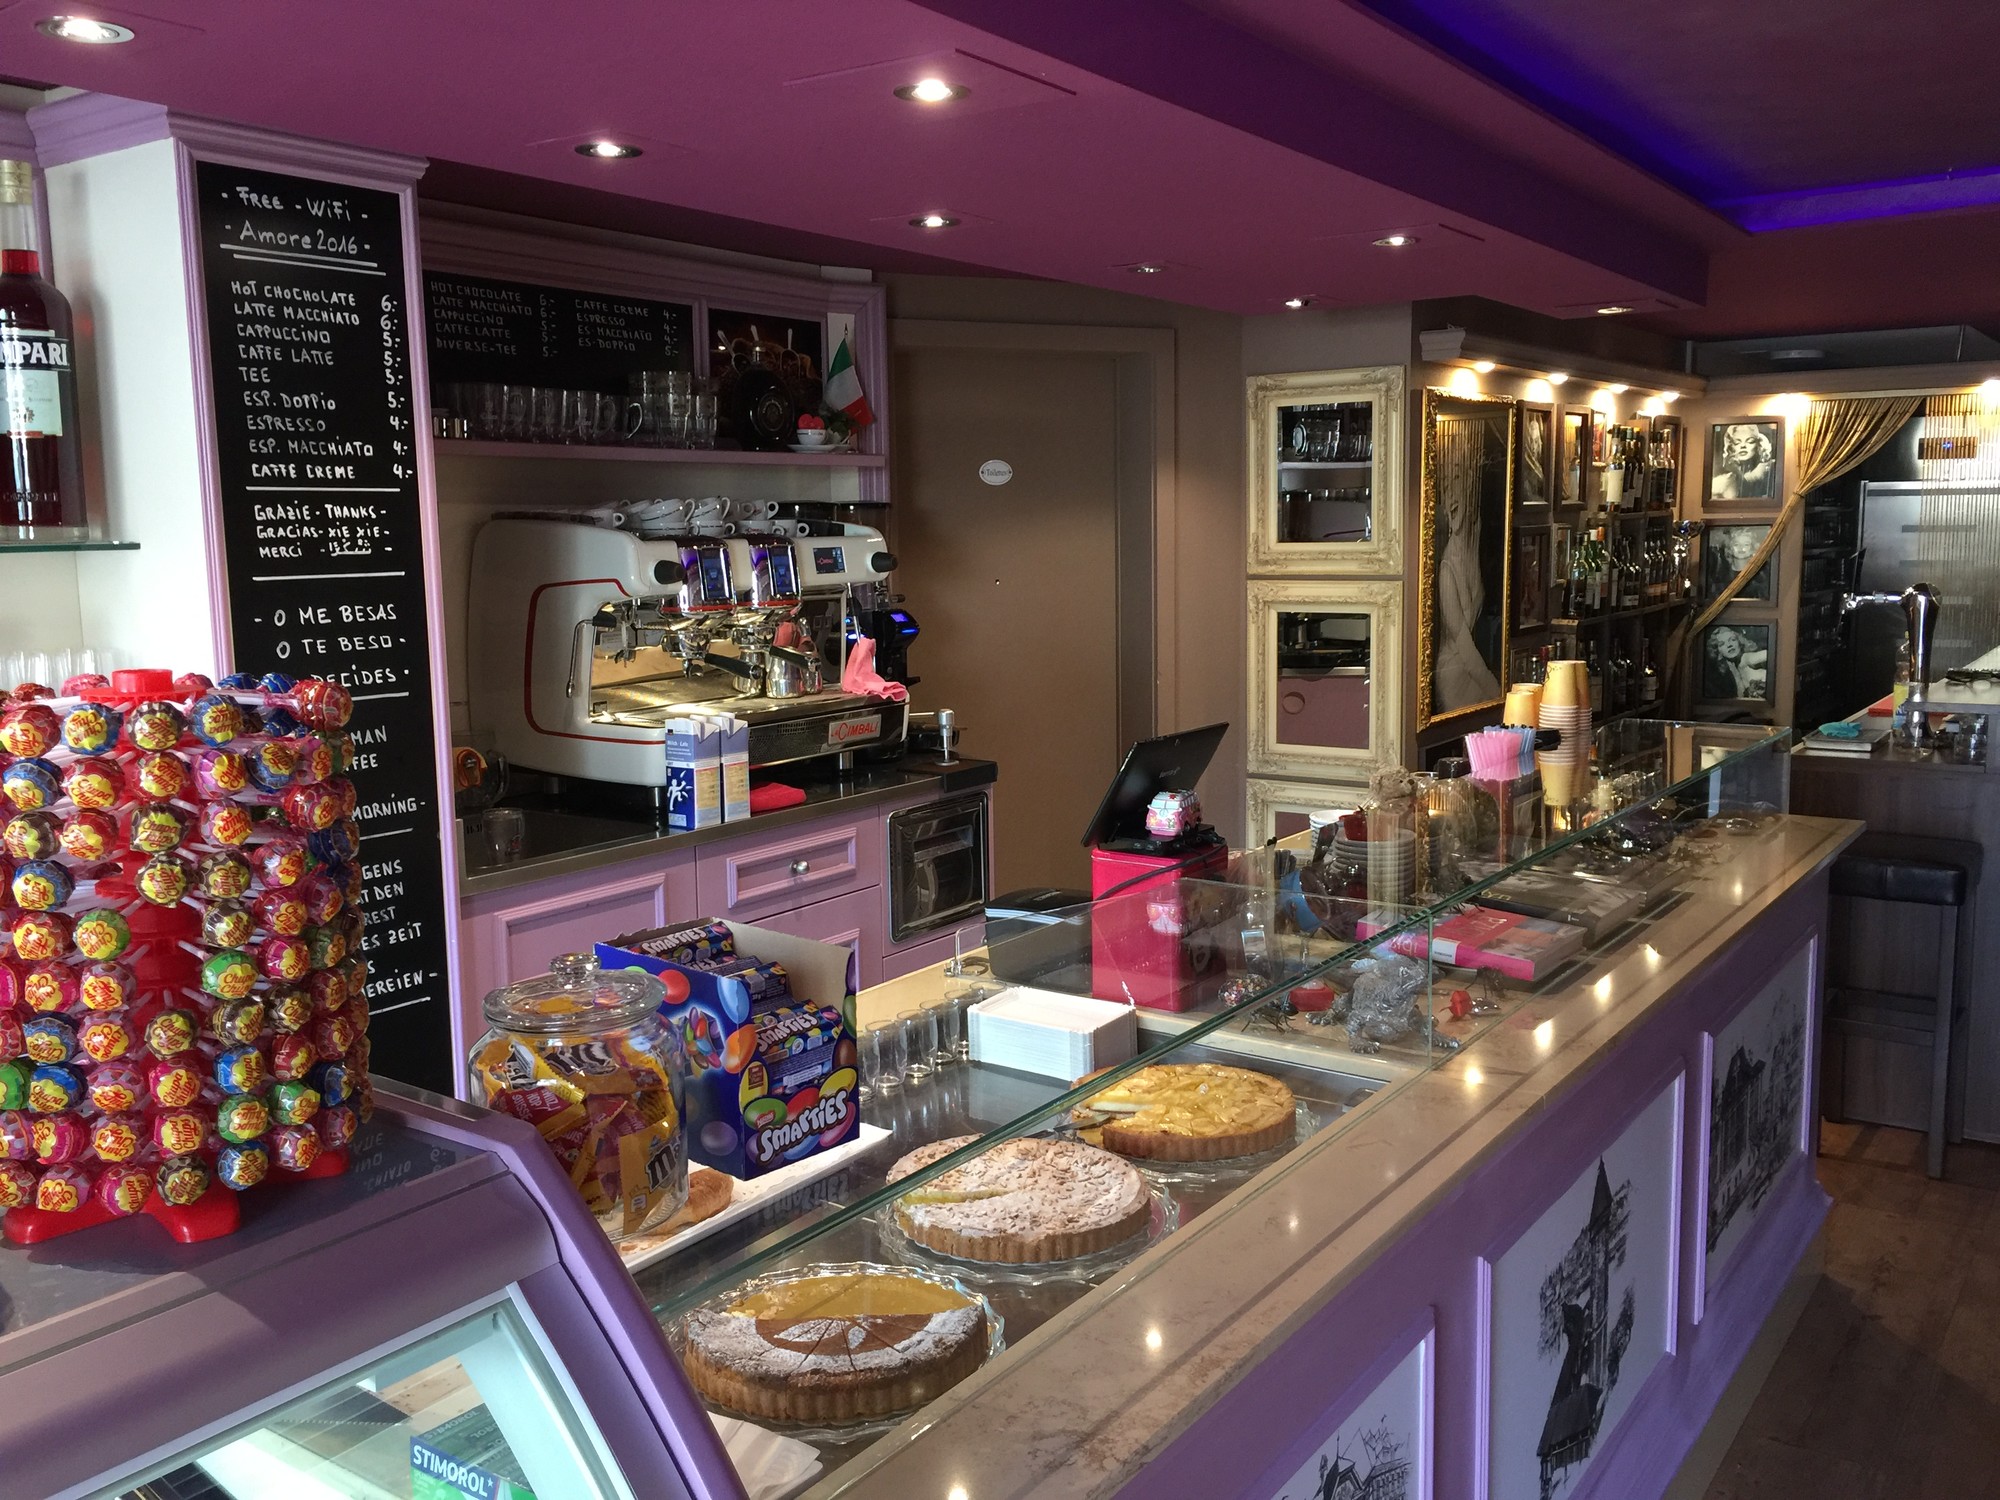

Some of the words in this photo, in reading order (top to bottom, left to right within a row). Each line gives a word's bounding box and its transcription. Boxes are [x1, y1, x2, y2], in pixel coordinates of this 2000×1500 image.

[231, 281, 256, 296] HOT
[264, 285, 356, 306] CHOCHOLATE
[430, 280, 454, 293] HOT
[456, 284, 521, 302] CHOCOLATE
[234, 302, 276, 318] LATTE
[284, 306, 360, 326] MACCHIATO
[432, 296, 464, 308] LATTE
[470, 300, 532, 316] MACCHIATO
[614, 304, 649, 318] CREME
[434, 308, 504, 326] CAPPUCCINO
[576, 312, 626, 326] ESPRESSO
[237, 324, 330, 344] CAPPUCCINO
[475, 326, 511, 340] LATTE
[597, 326, 652, 341] MACCHIATO
[0, 341, 69, 366] MPARI
[238, 344, 282, 361] CAFFE
[291, 348, 334, 366] LATTE
[238, 366, 271, 382] TEE
[244, 390, 277, 407] ESP.
[280, 392, 336, 410] DOPPIO
[247, 414, 326, 432] ESPRESSO
[249, 437, 281, 454] ESP.
[288, 436, 374, 456] MACCHIATO
[251, 464, 297, 479] CAFFE
[306, 464, 356, 480] CREME
[254, 500, 311, 522] GRAZIE
[325, 504, 376, 520] THANKS
[259, 542, 302, 559] MERCI
[274, 609, 286, 627] O
[299, 605, 332, 625] ME
[338, 604, 397, 623] BESAS
[276, 641, 291, 659] O
[302, 638, 327, 655] TE
[338, 635, 392, 652] BESO
[347, 753, 378, 770] FEE
[362, 859, 404, 880] GENS
[374, 882, 404, 900] DEN
[361, 934, 382, 950] ES
[388, 921, 422, 945] ZEIT
[362, 968, 423, 998] EREIEN
[760, 1090, 848, 1162] SMARTIES
[413, 1444, 488, 1498] STIMOROL
